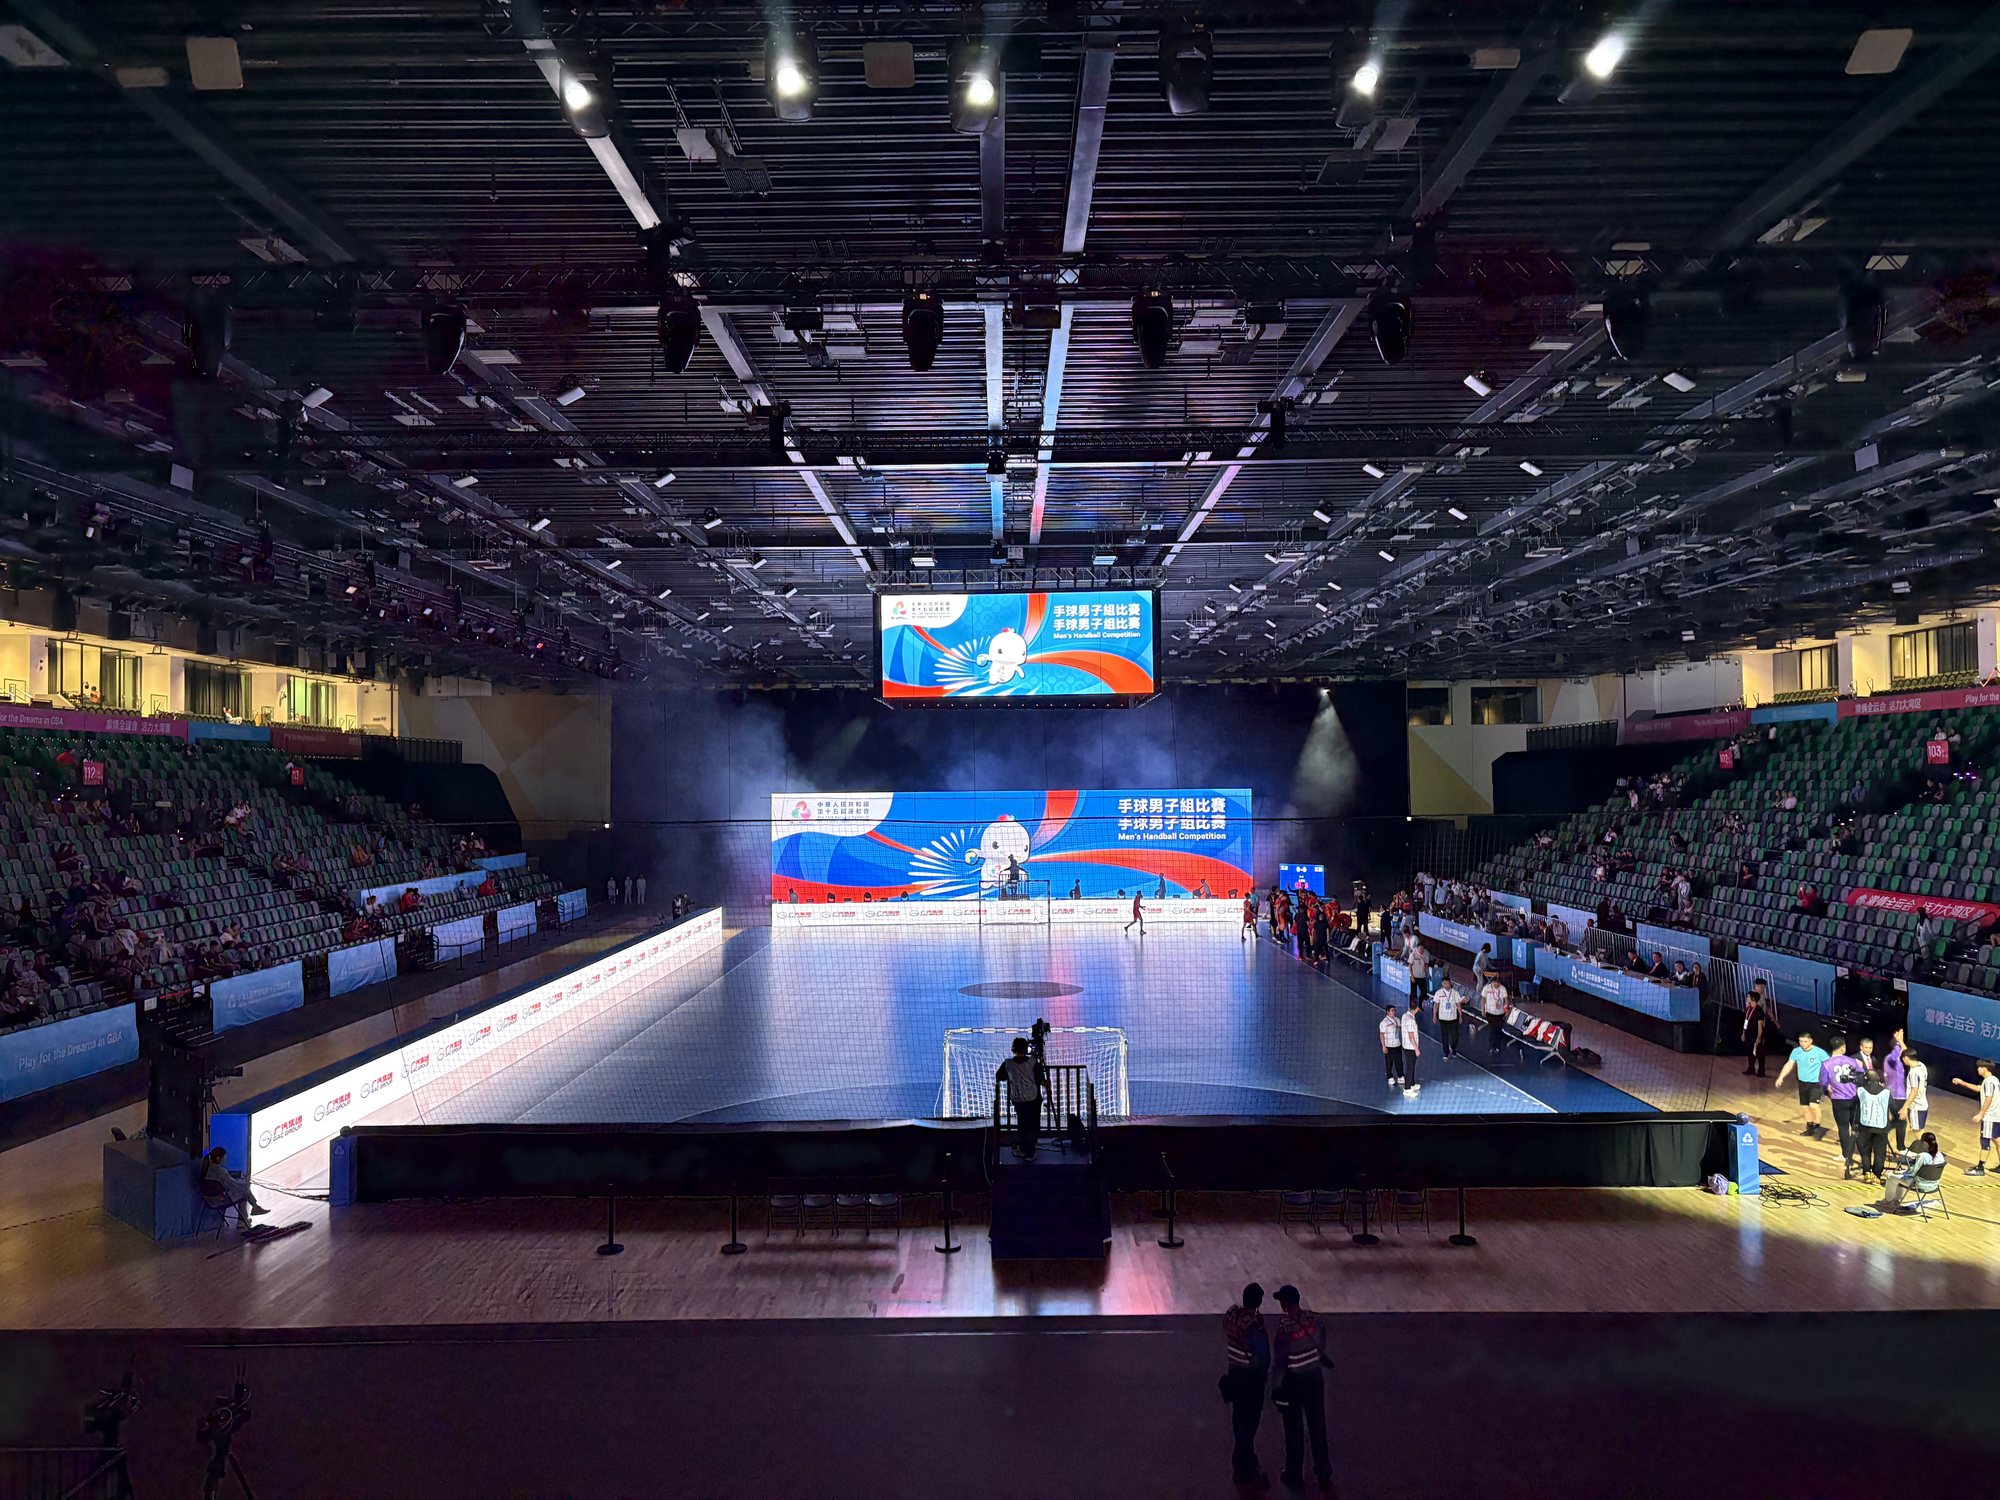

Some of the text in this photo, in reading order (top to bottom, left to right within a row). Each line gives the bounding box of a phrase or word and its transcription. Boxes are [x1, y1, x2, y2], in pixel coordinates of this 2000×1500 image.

[1053, 603, 1140, 617] 手球男子組比賽
[1053, 617, 1140, 631] 手球男子组比赛
[1102, 631, 1141, 639] Competition
[1965, 694, 1979, 705] Play
[1979, 693, 1989, 702] for
[8, 712, 19, 722] the
[19, 714, 43, 724] Dreams
[43, 716, 50, 724] in
[1928, 745, 1942, 757] 103
[84, 766, 96, 779] 112
[1118, 797, 1226, 813] 手球男子組比賽
[1118, 815, 1226, 830] 手球男子组比赛
[1143, 832, 1177, 840] Handball
[1179, 832, 1227, 841] Competition
[18, 1031, 123, 1071] Play for the Dreams in GBA
[285, 1123, 303, 1136] GROUP
